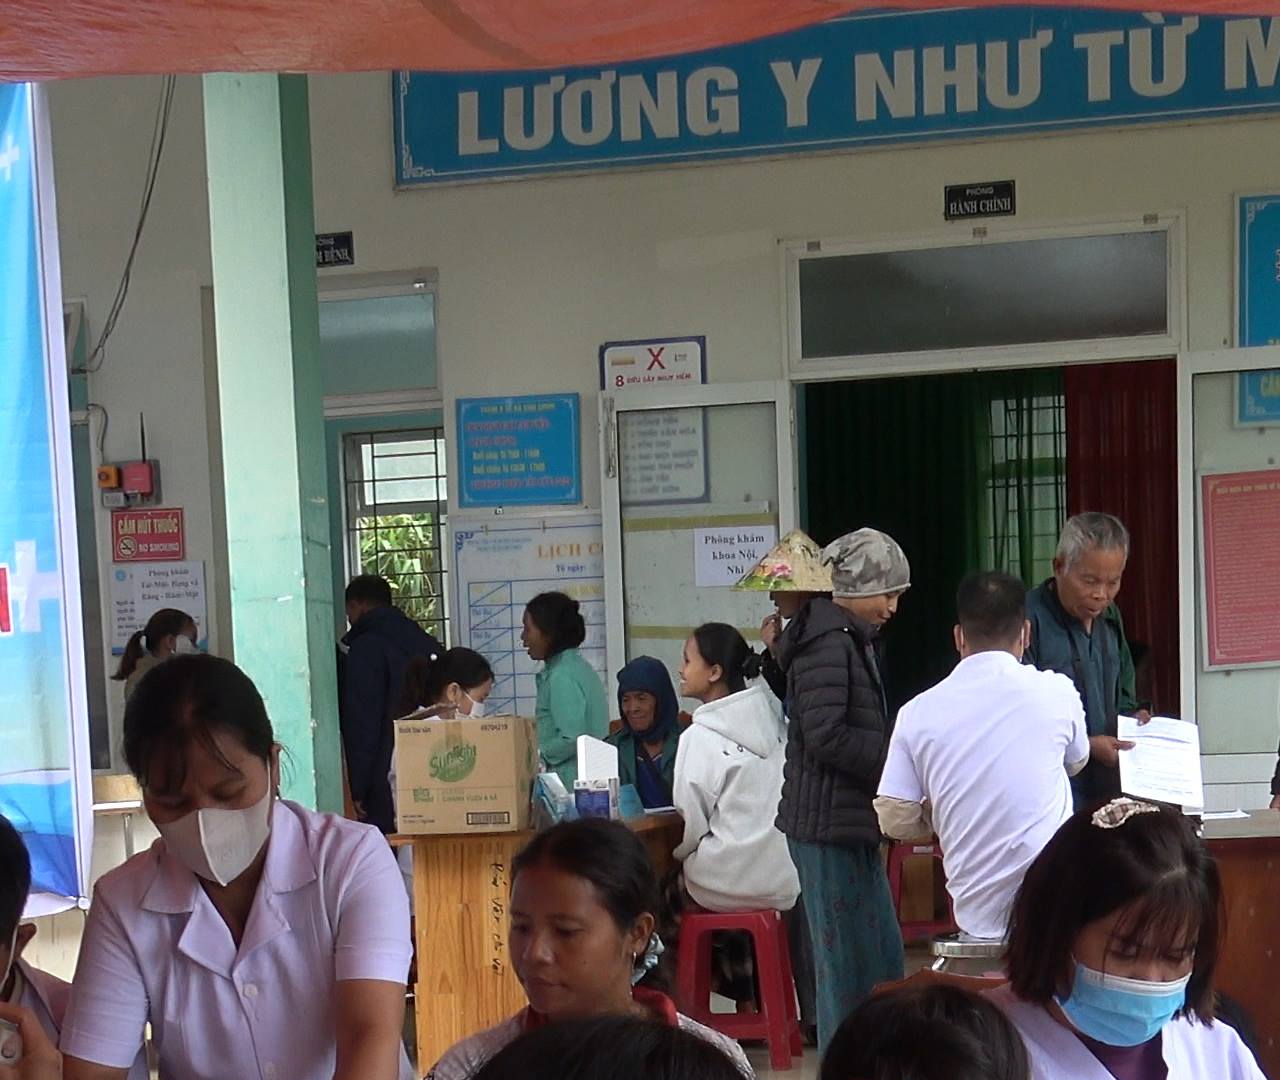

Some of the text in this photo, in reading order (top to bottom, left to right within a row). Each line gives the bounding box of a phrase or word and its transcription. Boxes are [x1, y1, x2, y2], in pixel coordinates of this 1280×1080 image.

[458, 69, 740, 156] LƯƠNG
[770, 58, 822, 128] Y
[854, 29, 1054, 122] NHƯ
[1073, 12, 1200, 102] TỪ
[615, 375, 625, 387] 8
[704, 533, 764, 545] Phòng khám
[712, 551, 736, 560] khoa
